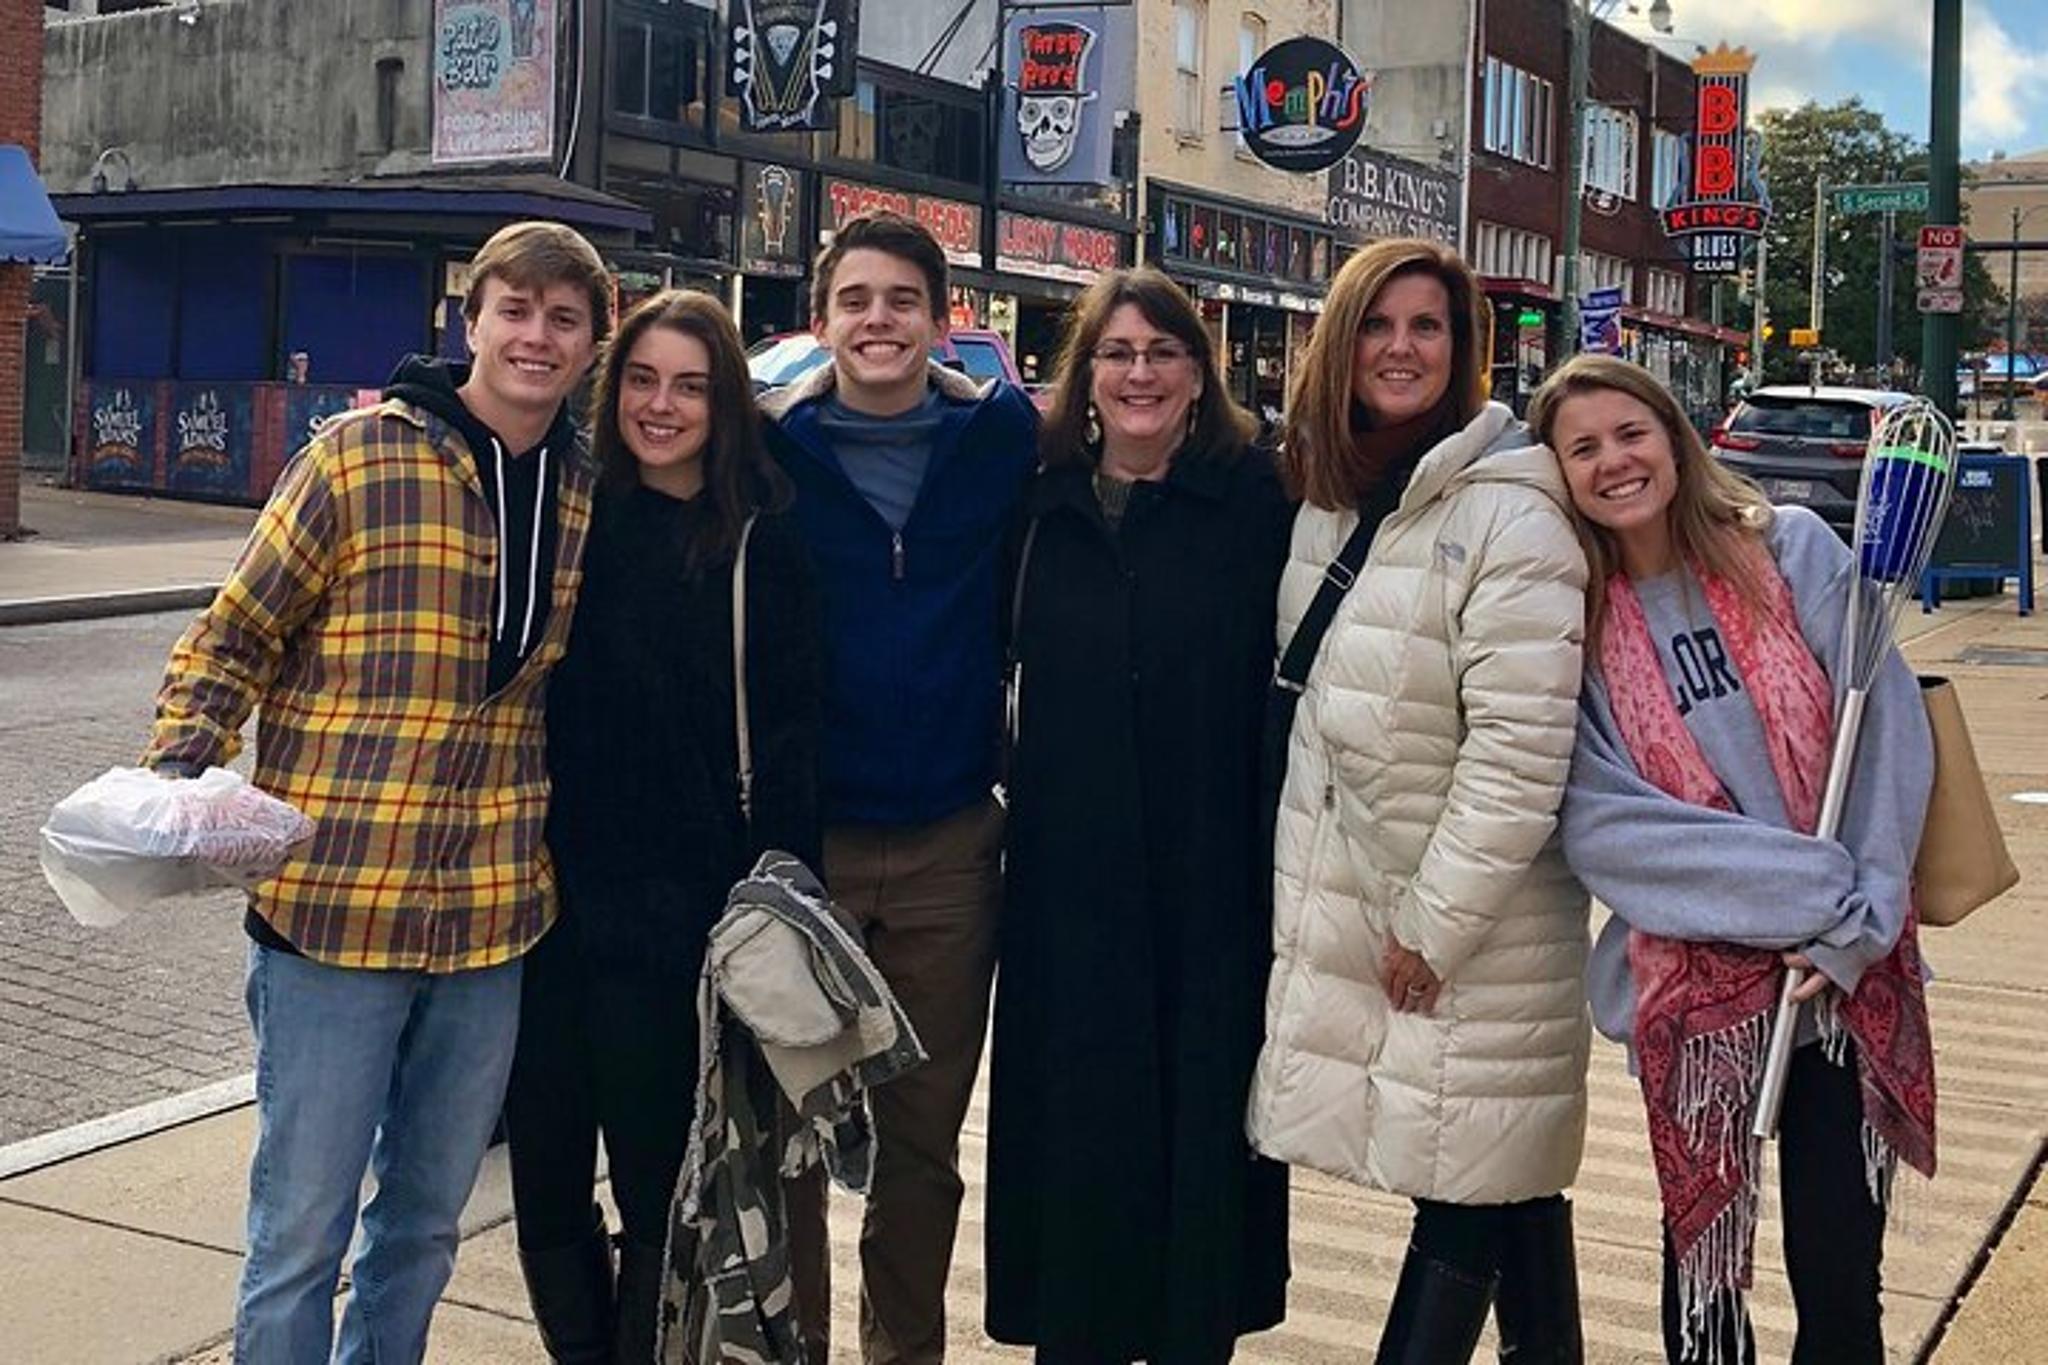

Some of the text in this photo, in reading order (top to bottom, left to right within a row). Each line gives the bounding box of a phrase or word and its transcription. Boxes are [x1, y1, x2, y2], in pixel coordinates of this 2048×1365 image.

[1233, 61, 1370, 135] Memphis
[1383, 166, 1449, 218] KING'S
[1328, 196, 1405, 236] COMPANY
[1670, 206, 1760, 229] KING'S
[1694, 235, 1736, 257] BLUES
[1926, 230, 1956, 246] NO
[1693, 260, 1737, 272] CLUB
[93, 410, 142, 432] SAMUEL
[177, 410, 229, 434] SAMUEL
